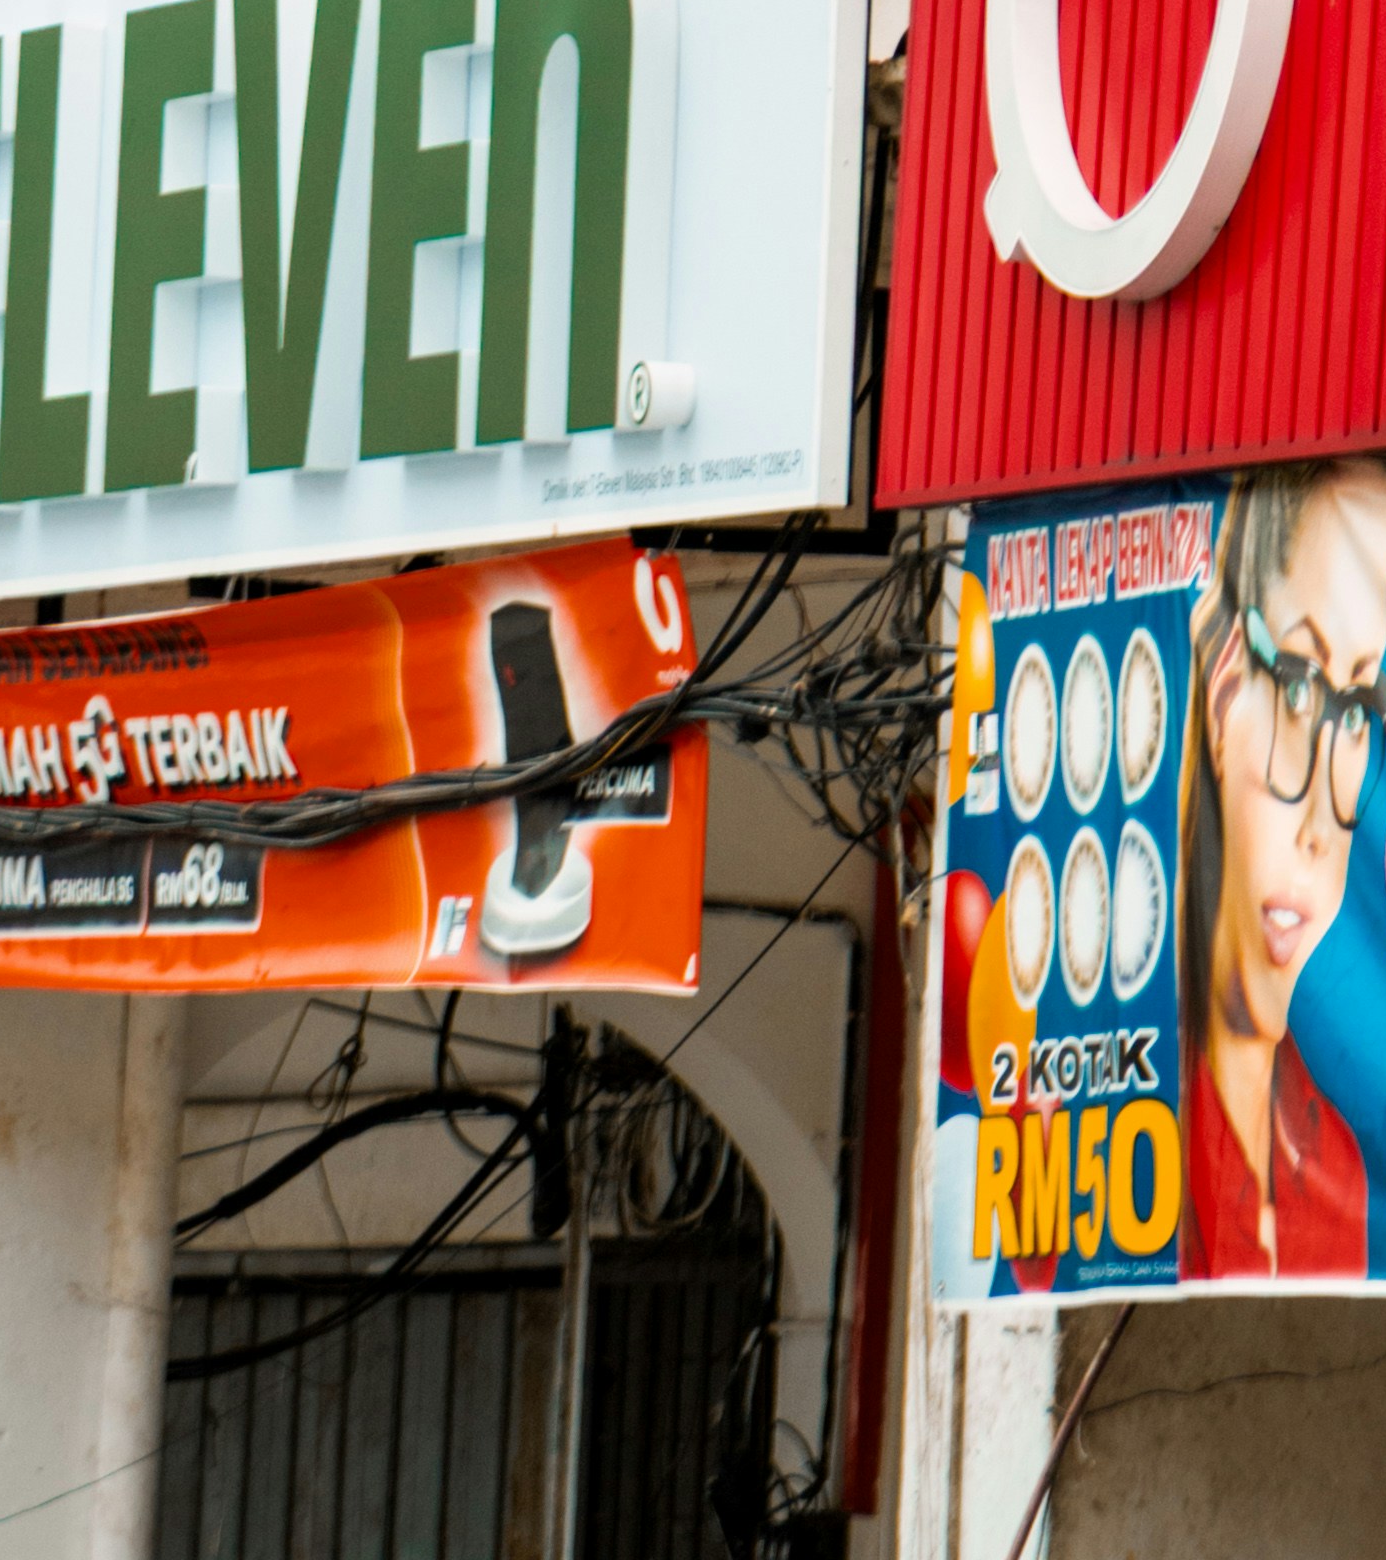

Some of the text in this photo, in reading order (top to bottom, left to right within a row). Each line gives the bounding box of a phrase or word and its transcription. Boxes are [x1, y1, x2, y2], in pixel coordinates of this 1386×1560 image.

[987, 525, 1051, 623] KANTA
[1053, 514, 1114, 612] LEKAP
[68, 693, 126, 804] 5G
[125, 706, 299, 790] TERBAIK
[576, 765, 655, 800] PERCUMA
[990, 1027, 1159, 1106] 2 KOTAK
[972, 1098, 1183, 1262] RM50
